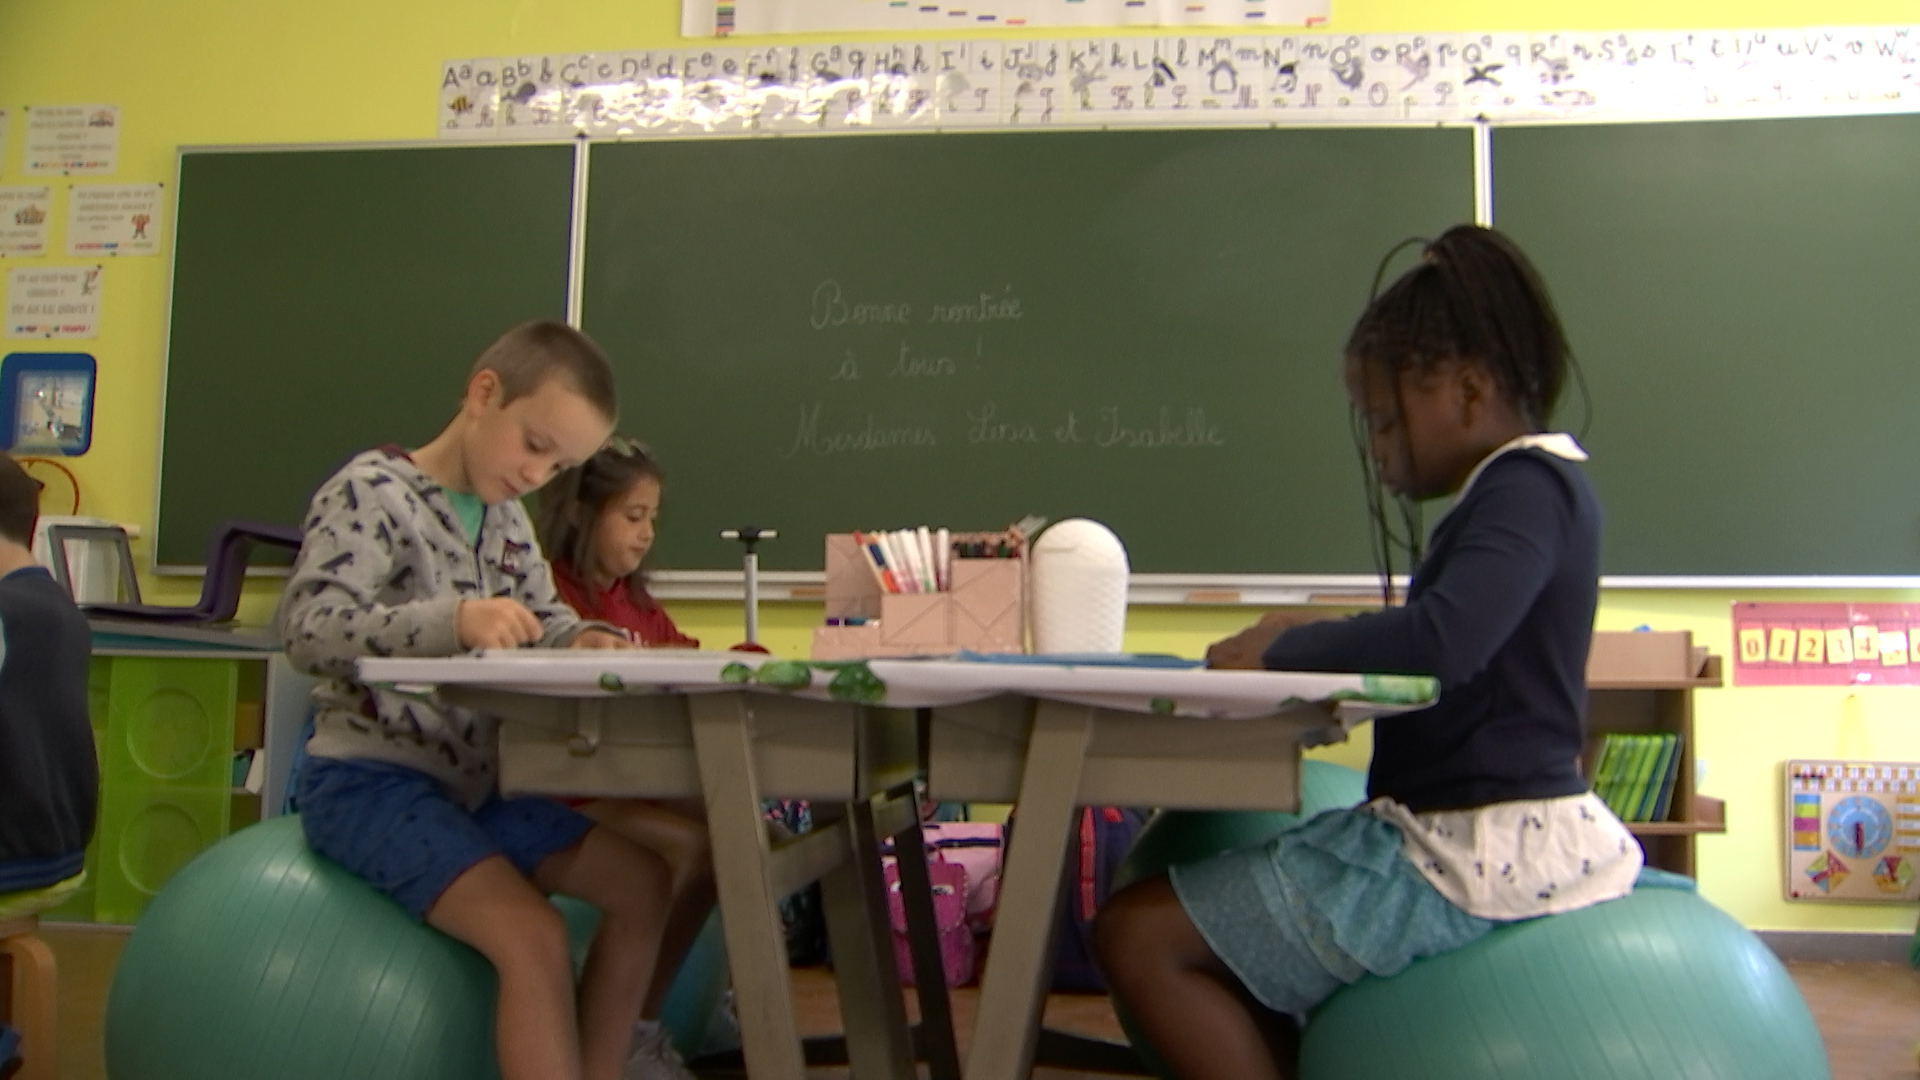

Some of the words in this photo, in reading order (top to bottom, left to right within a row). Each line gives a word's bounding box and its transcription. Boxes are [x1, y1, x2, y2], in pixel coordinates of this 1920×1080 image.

[810, 279, 911, 331] Bonne
[830, 349, 861, 381] à
[888, 341, 956, 378] tous
[779, 400, 937, 460] Mesdames
[1054, 410, 1083, 443] et
[1096, 404, 1224, 448] Isabelle
[1804, 638, 1816, 657] 2
